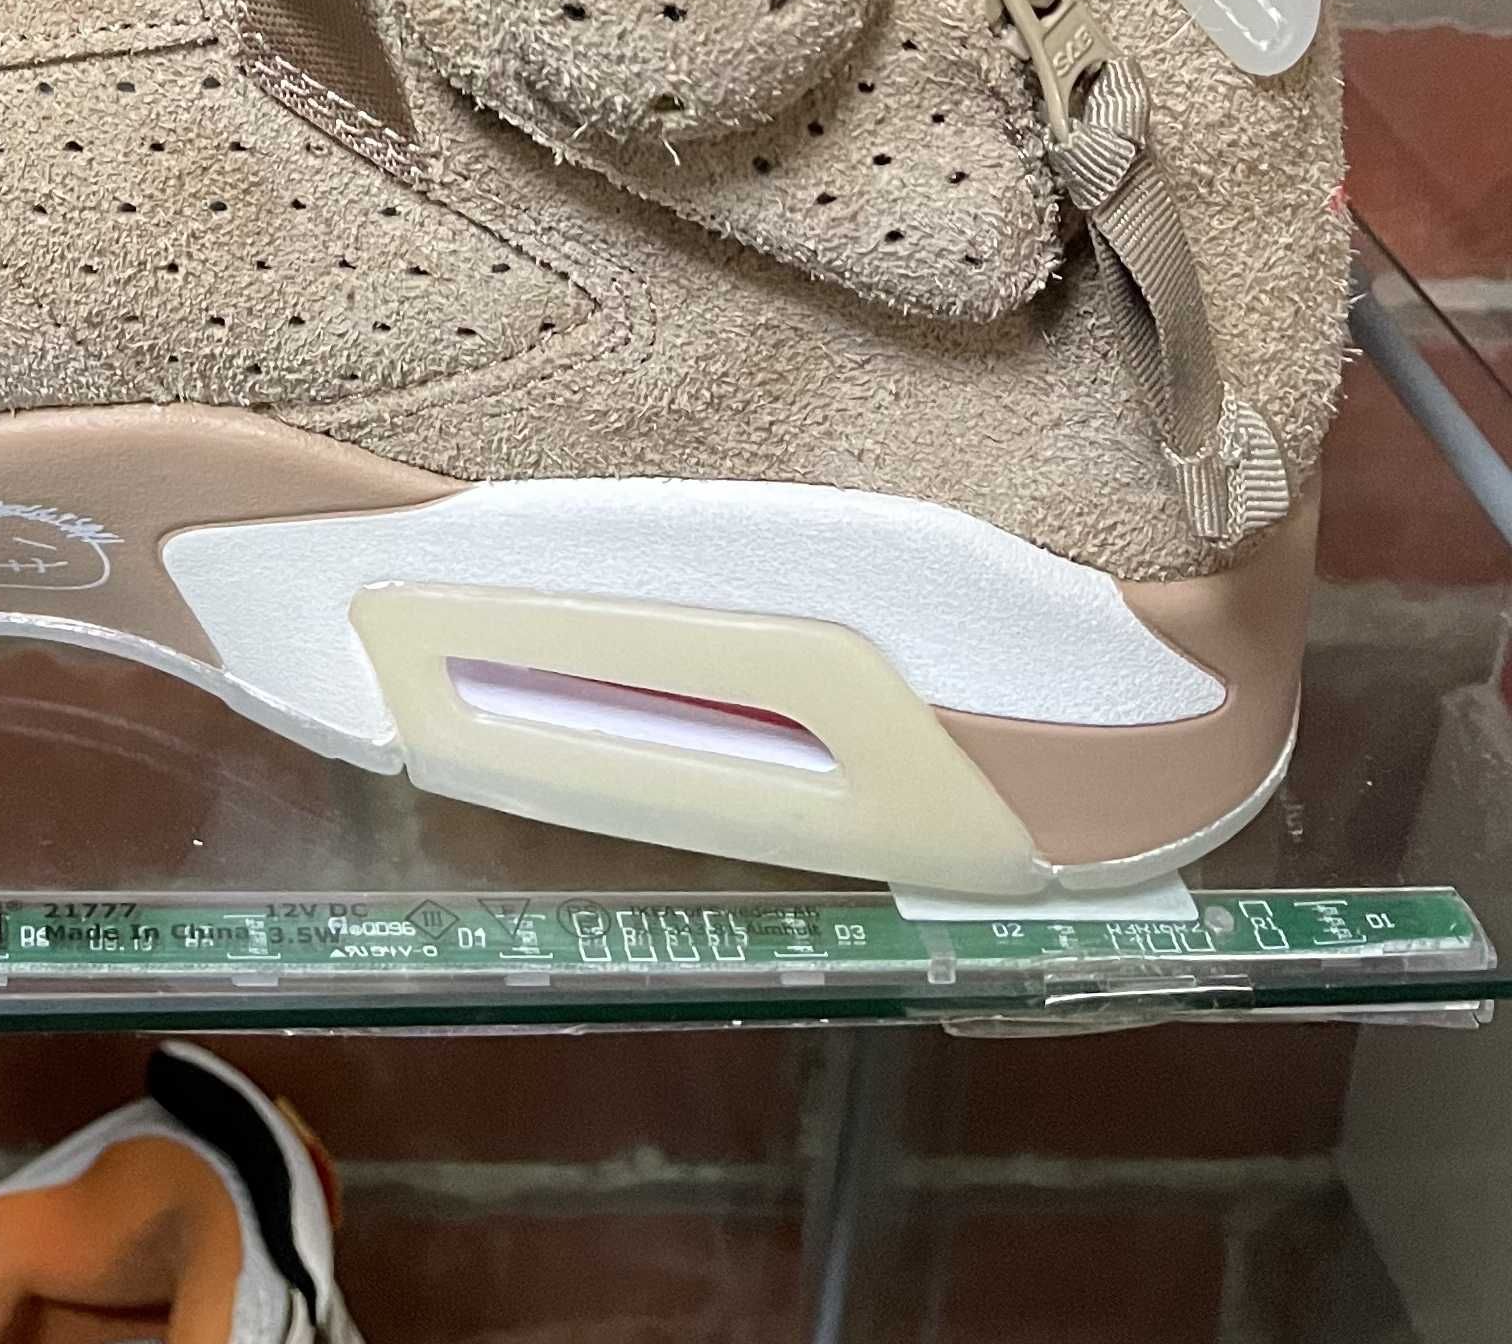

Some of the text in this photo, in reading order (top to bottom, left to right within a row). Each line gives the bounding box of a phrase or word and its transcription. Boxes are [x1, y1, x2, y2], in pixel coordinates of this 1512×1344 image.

[44, 903, 138, 919] 21777
[266, 903, 369, 918] 12V DC
[45, 924, 119, 941] Made
